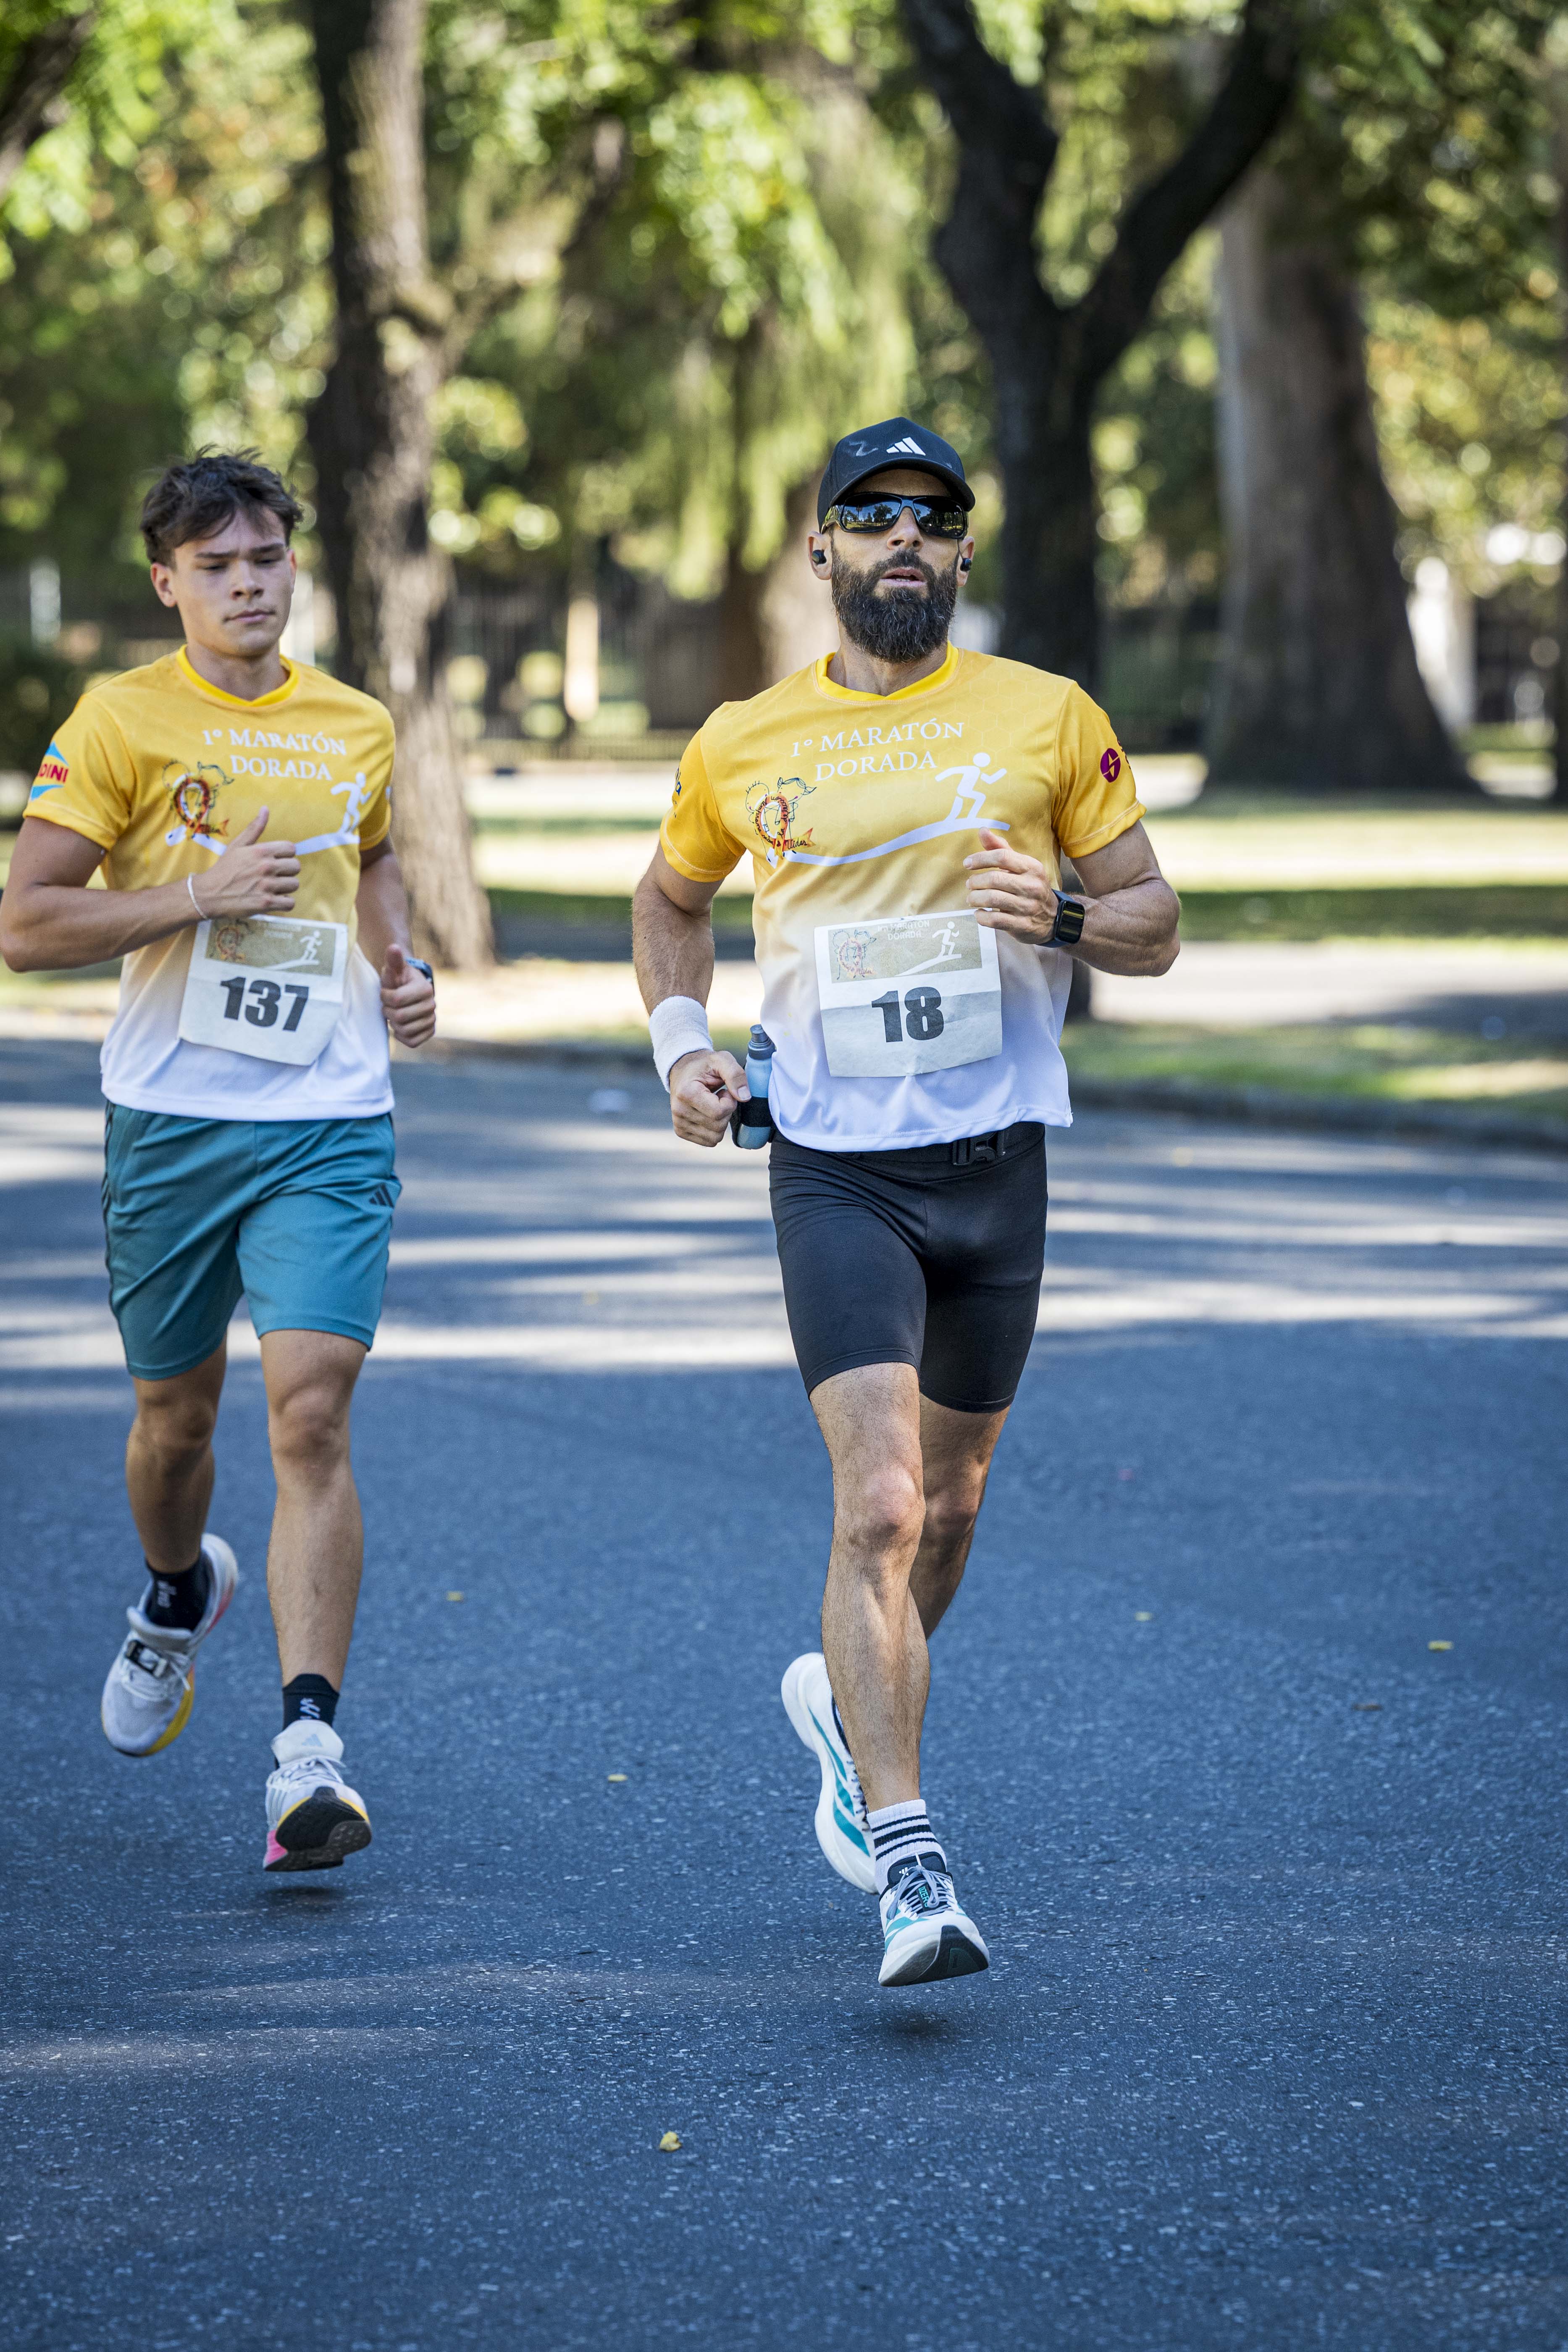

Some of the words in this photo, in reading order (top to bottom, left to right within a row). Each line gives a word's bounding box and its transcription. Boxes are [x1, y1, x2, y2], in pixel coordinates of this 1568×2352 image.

[229, 728, 346, 755] MARATÓN
[819, 718, 964, 752] MARATÓN
[230, 754, 333, 780] DORADA
[814, 751, 938, 781] DORADA
[220, 976, 310, 1032] 137
[871, 986, 944, 1043] 18
